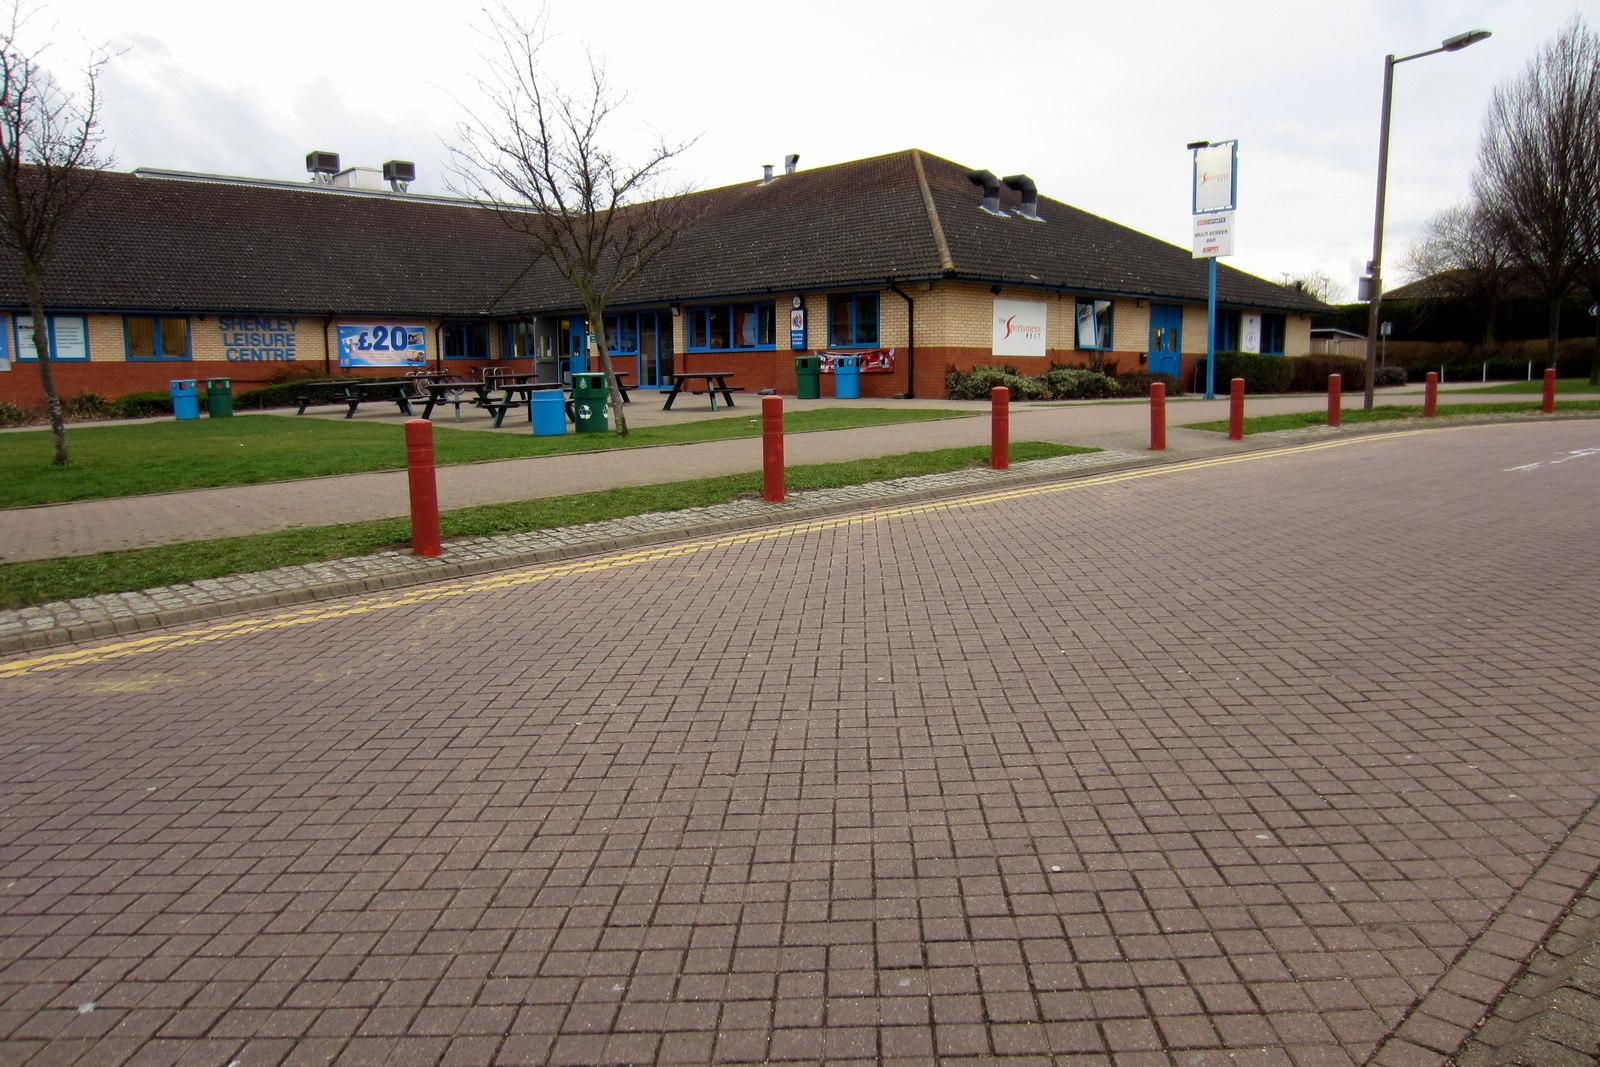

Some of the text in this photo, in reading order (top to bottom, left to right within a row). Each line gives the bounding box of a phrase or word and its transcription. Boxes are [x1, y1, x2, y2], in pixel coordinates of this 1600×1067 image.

[218, 318, 298, 332] SHENLEY
[223, 332, 296, 347] LEISURE
[357, 325, 408, 351] £20
[226, 347, 296, 362] CENTRE
